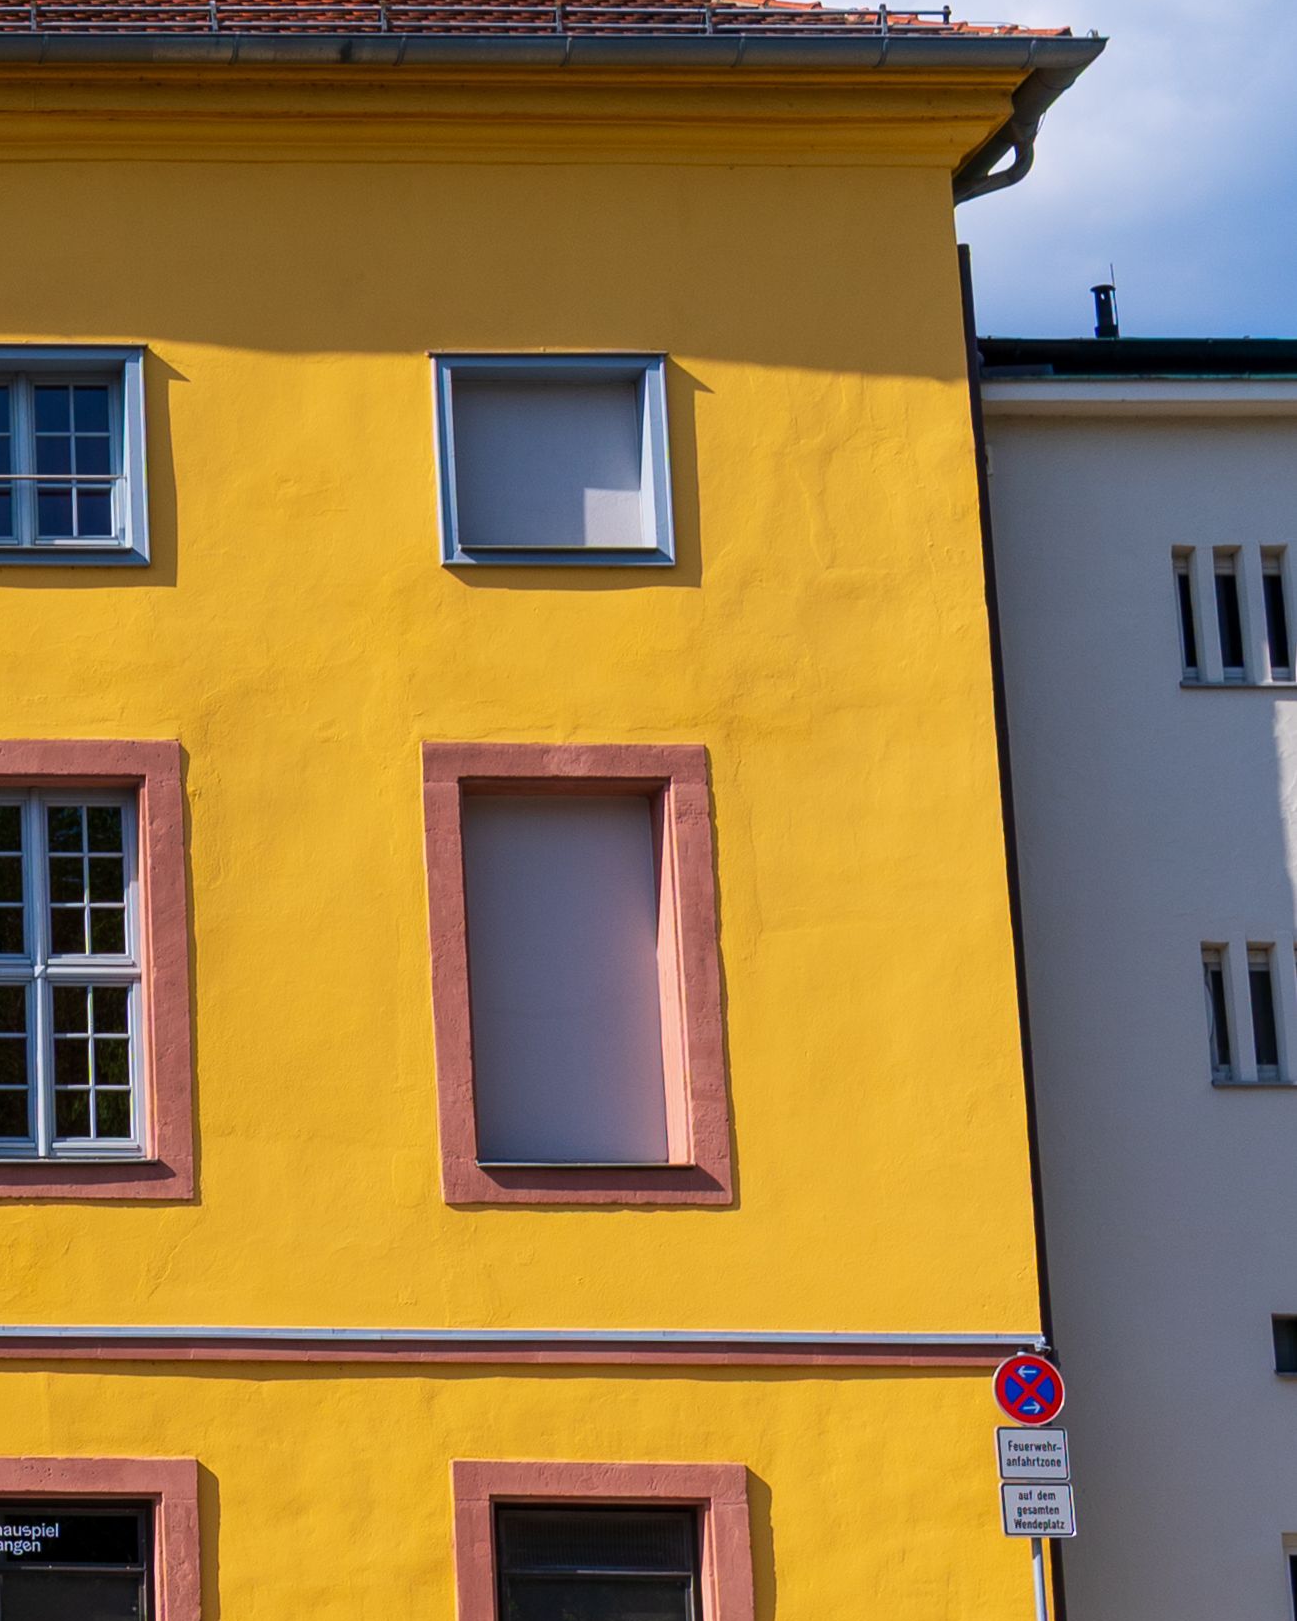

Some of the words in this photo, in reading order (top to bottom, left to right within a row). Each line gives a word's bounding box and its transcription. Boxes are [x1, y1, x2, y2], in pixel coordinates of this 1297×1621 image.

[1007, 1440, 1062, 1452] Feuerwehr-
[1006, 1456, 1062, 1468] anfahrtzone
[1018, 1489, 1033, 1501] auf
[1037, 1489, 1057, 1501] dem
[1016, 1505, 1060, 1518] gesamten
[1013, 1518, 1066, 1532] Wendeplatz
